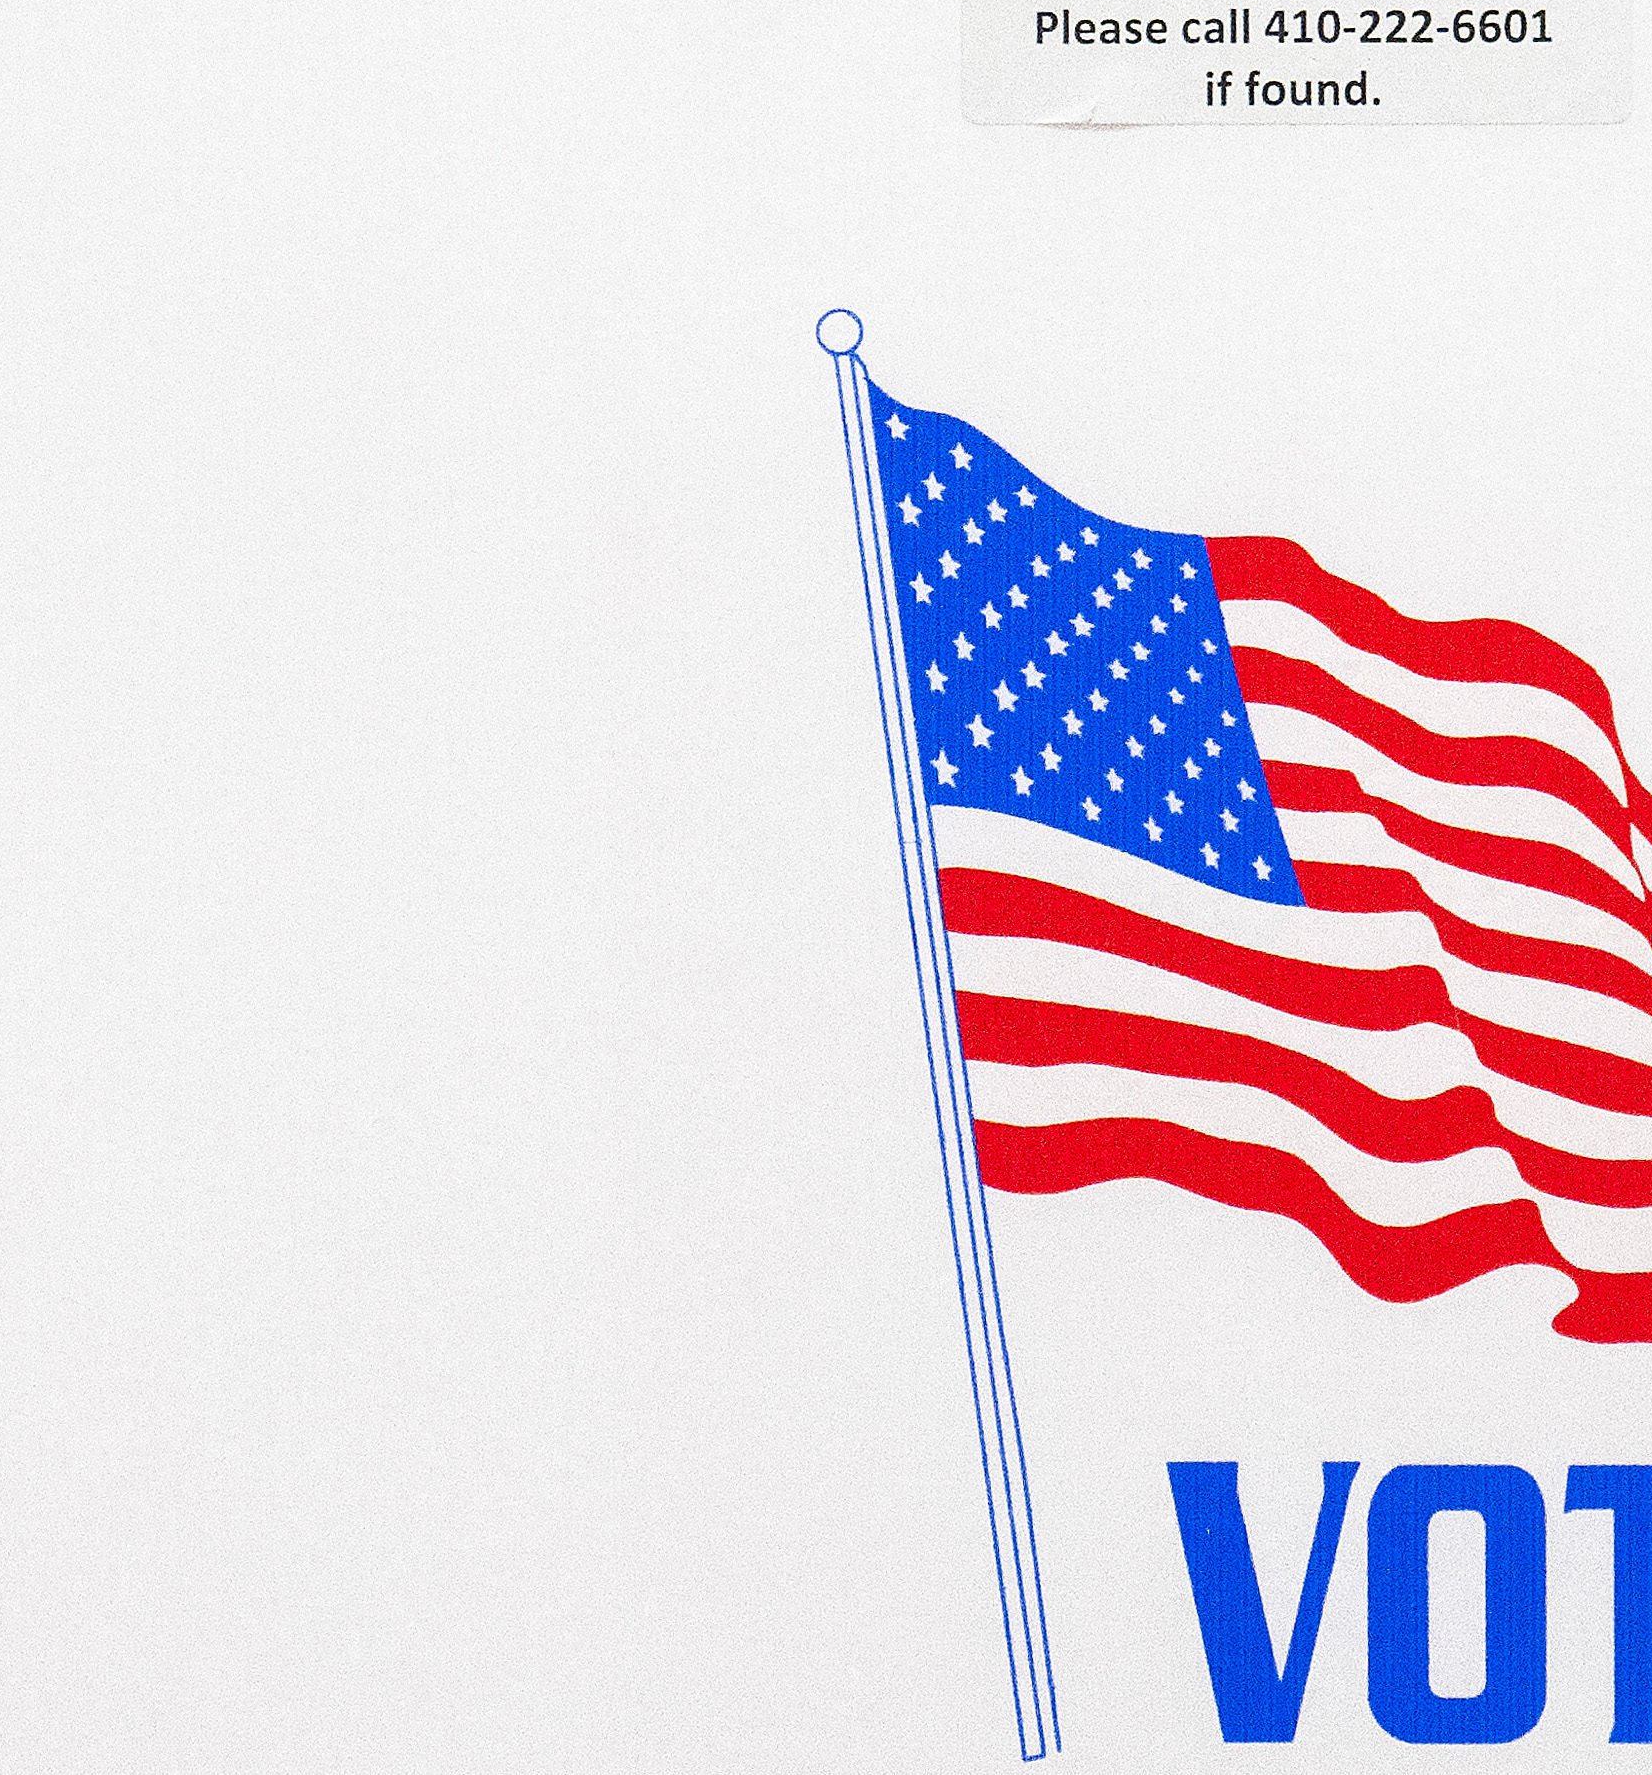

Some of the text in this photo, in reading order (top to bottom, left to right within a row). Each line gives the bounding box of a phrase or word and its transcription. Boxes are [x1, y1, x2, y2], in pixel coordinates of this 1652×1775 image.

[1036, 8, 1553, 45] Please call 410-222-6601
[1206, 69, 1381, 107] if found.
